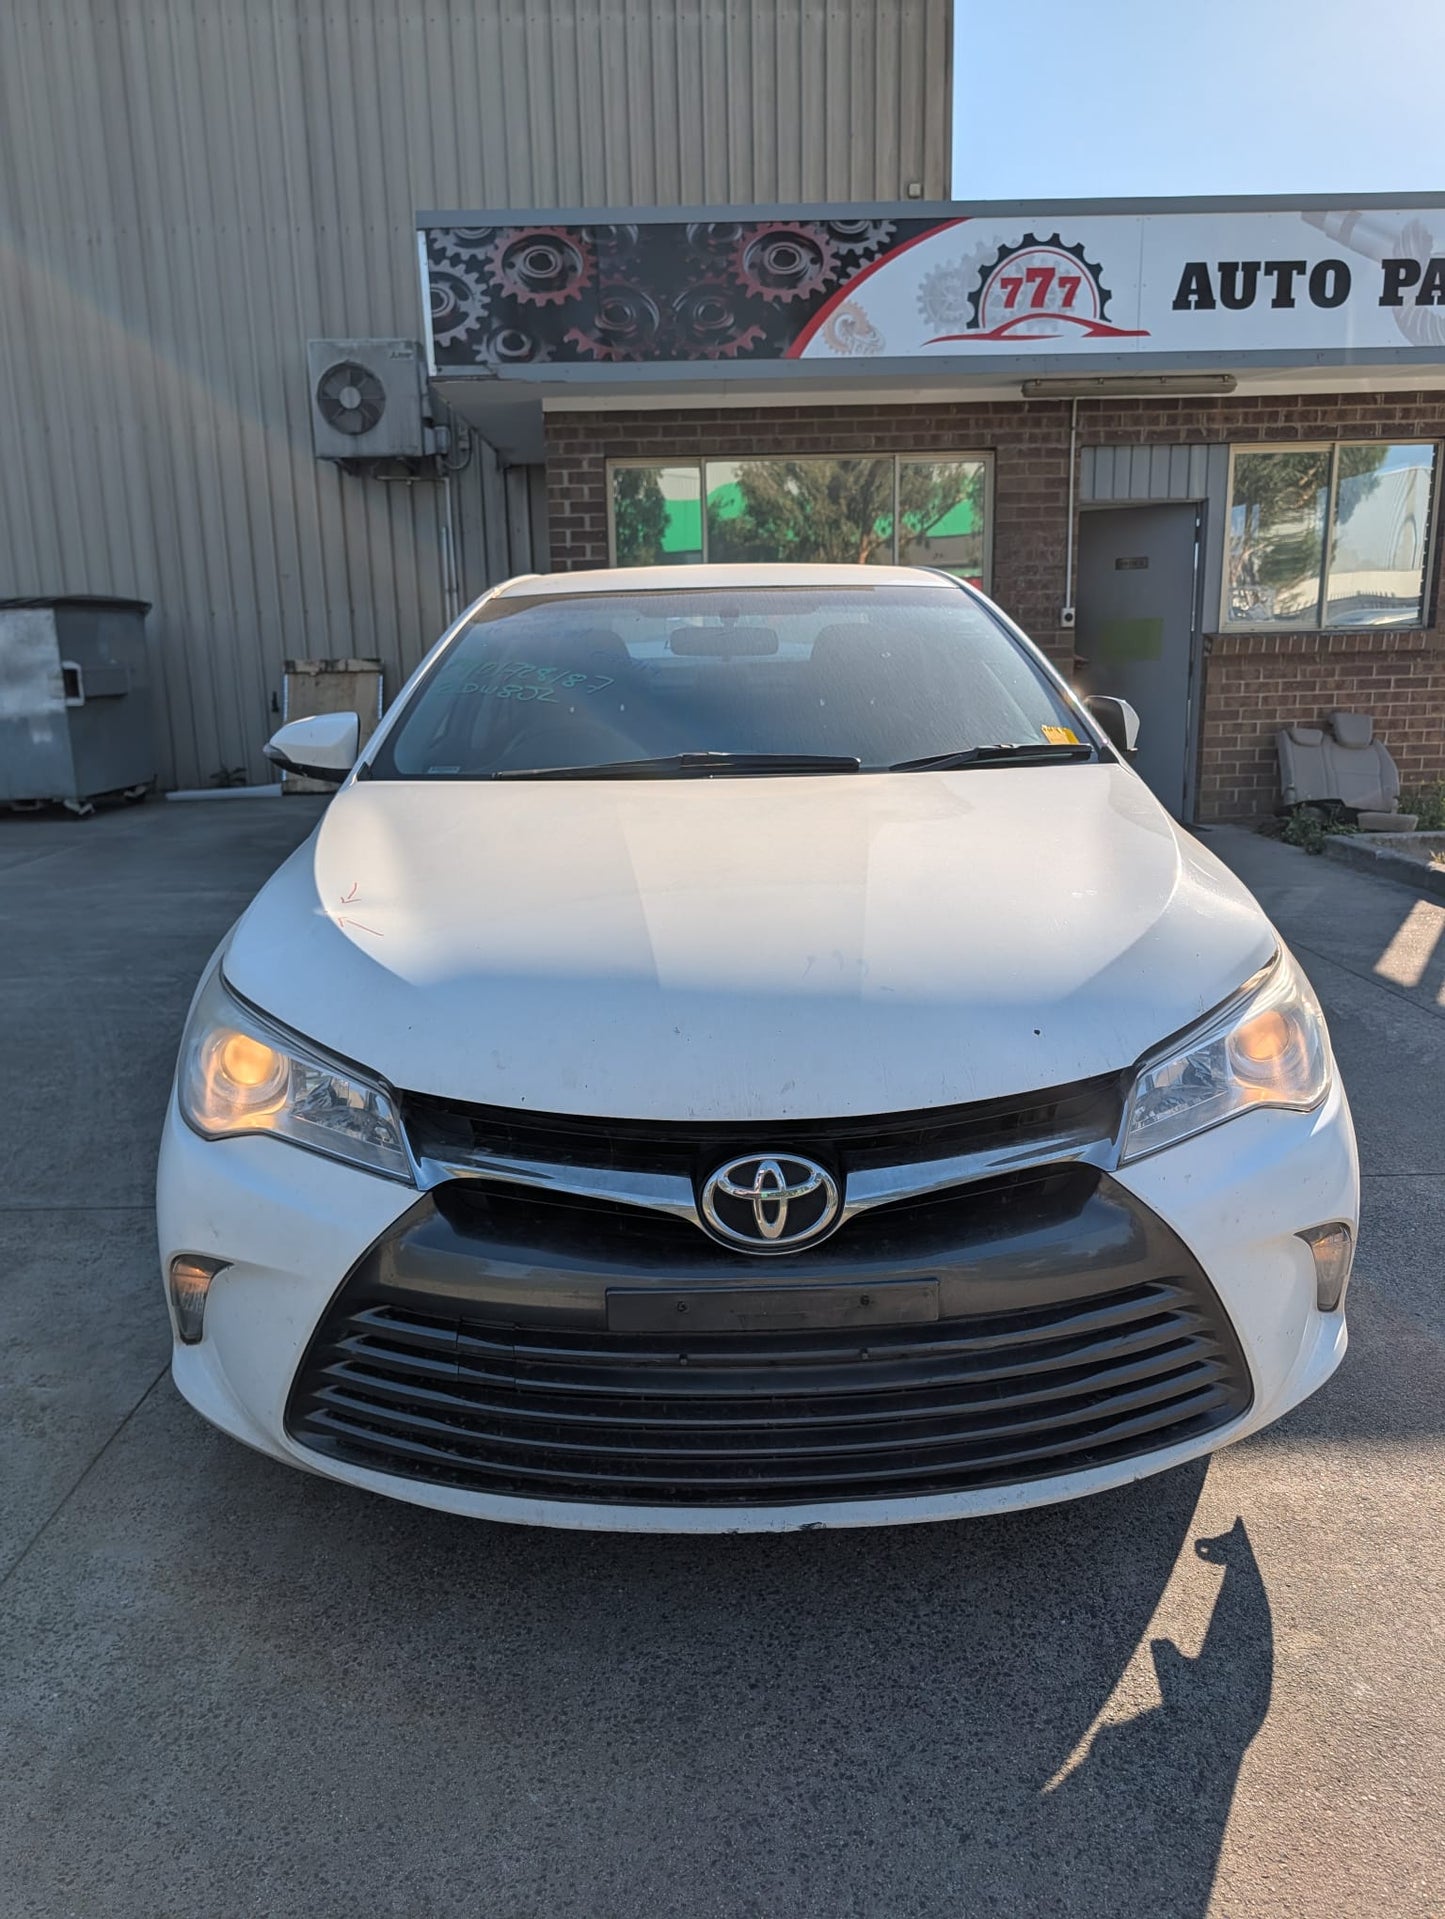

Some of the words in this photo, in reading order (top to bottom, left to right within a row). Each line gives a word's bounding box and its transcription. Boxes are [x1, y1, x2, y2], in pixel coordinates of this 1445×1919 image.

[1000, 267, 1082, 309] 777
[1172, 259, 1352, 311] AUTO
[1378, 258, 1445, 307] PA
